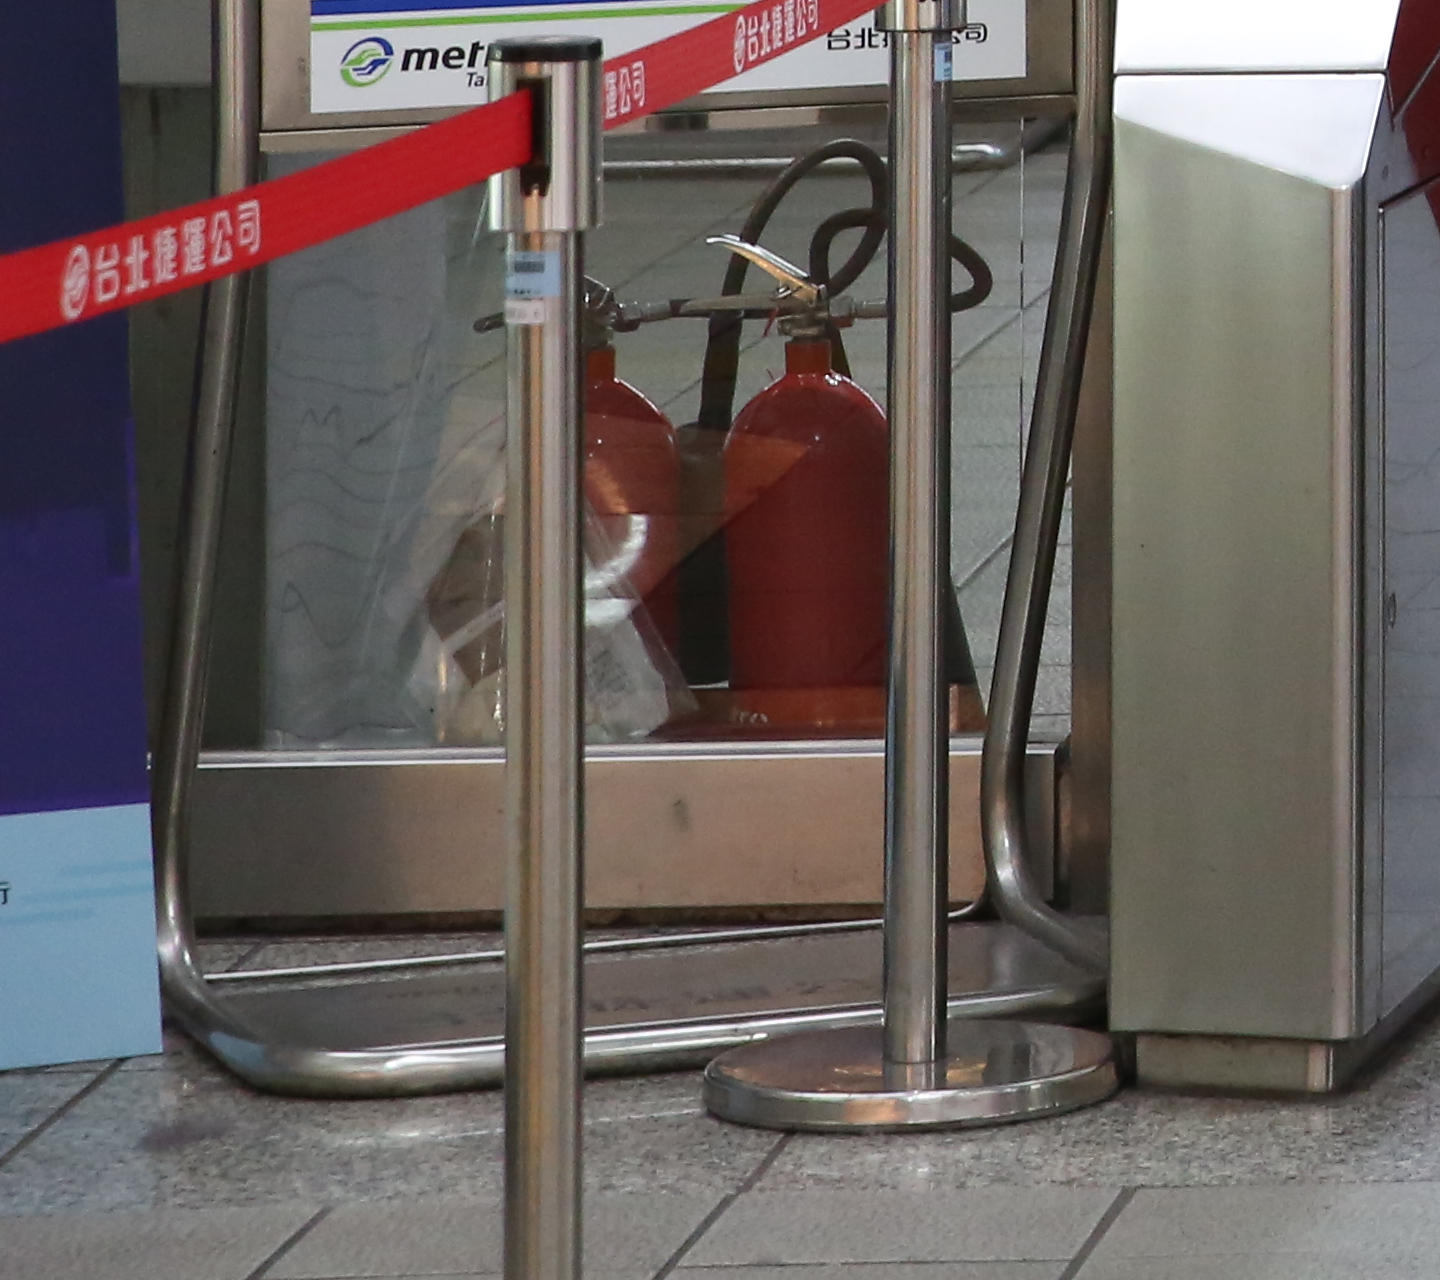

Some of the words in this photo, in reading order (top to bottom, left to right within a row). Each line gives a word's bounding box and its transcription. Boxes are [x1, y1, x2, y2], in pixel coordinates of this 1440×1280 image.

[95, 198, 261, 304] 台北捷運公司
